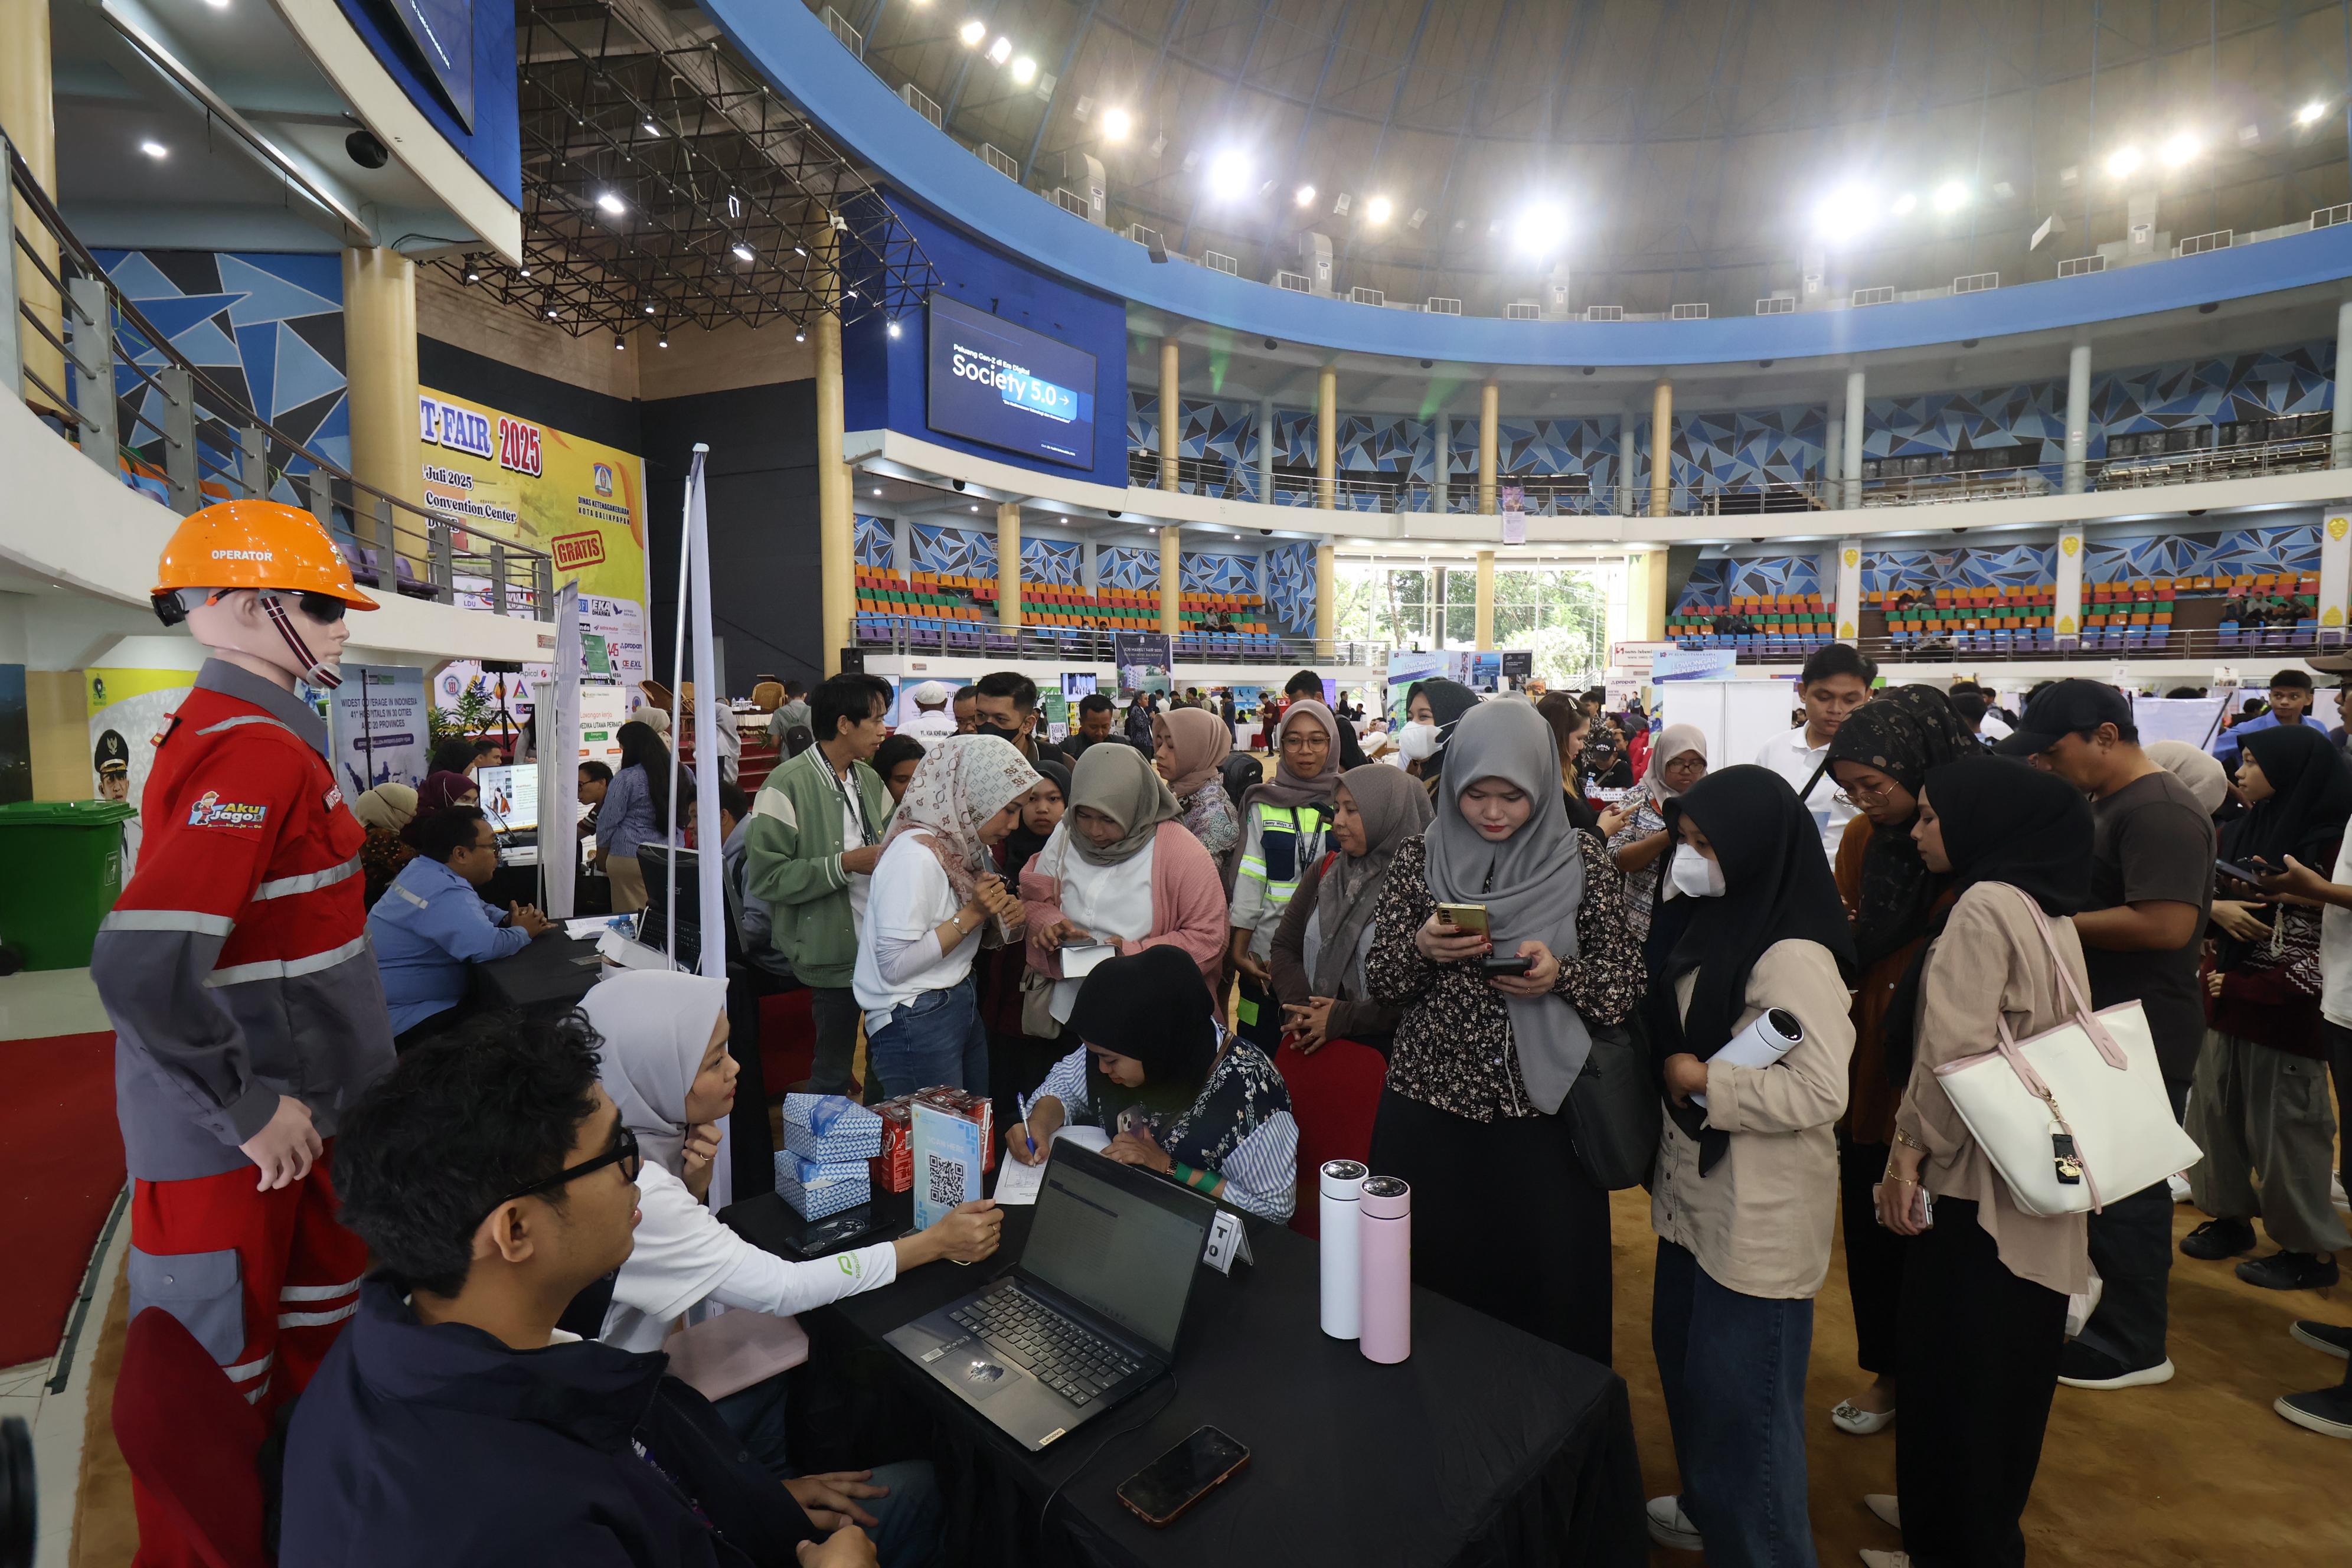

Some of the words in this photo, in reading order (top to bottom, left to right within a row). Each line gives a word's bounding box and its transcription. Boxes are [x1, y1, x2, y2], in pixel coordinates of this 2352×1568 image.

[953, 344, 978, 358] Peluang
[978, 353, 996, 364] Gen-Z
[1003, 361, 1012, 370] Era
[1012, 364, 1030, 376] Digital
[953, 354, 1026, 401] Society
[1031, 380, 1056, 406] 5.0
[421, 400, 435, 437] T
[442, 406, 490, 453] FAIR
[500, 419, 540, 473] 2025
[426, 467, 446, 482] Juli
[448, 472, 472, 488] 2025
[426, 492, 483, 515] Convention
[485, 505, 517, 522] Center
[578, 496, 592, 506] DINAS
[592, 500, 629, 515] KETENAGAKERJAAN
[579, 507, 593, 517] KOTA
[595, 511, 630, 525] BALIKPAPAN
[211, 550, 273, 561] OPERATOR
[557, 537, 600, 563] GRATIS
[592, 600, 610, 611] EKA
[1403, 658, 1436, 668] LOWONGAN
[1403, 664, 1436, 674] PEKERJAAN
[1672, 657, 1717, 668] LOWONGAN
[1672, 664, 1717, 674] PEKERJAAN
[520, 668, 538, 679] Apical
[341, 698, 360, 707] WIDEST
[602, 711, 612, 719] kerja
[380, 720, 405, 729] PROVINCES
[827, 762, 836, 776] NIXX
[223, 803, 260, 814] Aku
[209, 810, 254, 823] Jago
[926, 1136, 946, 1148] SCAN
[946, 1142, 964, 1154] HERE
[1217, 1226, 1228, 1239] T
[1042, 1430, 1062, 1443] Lenovo
